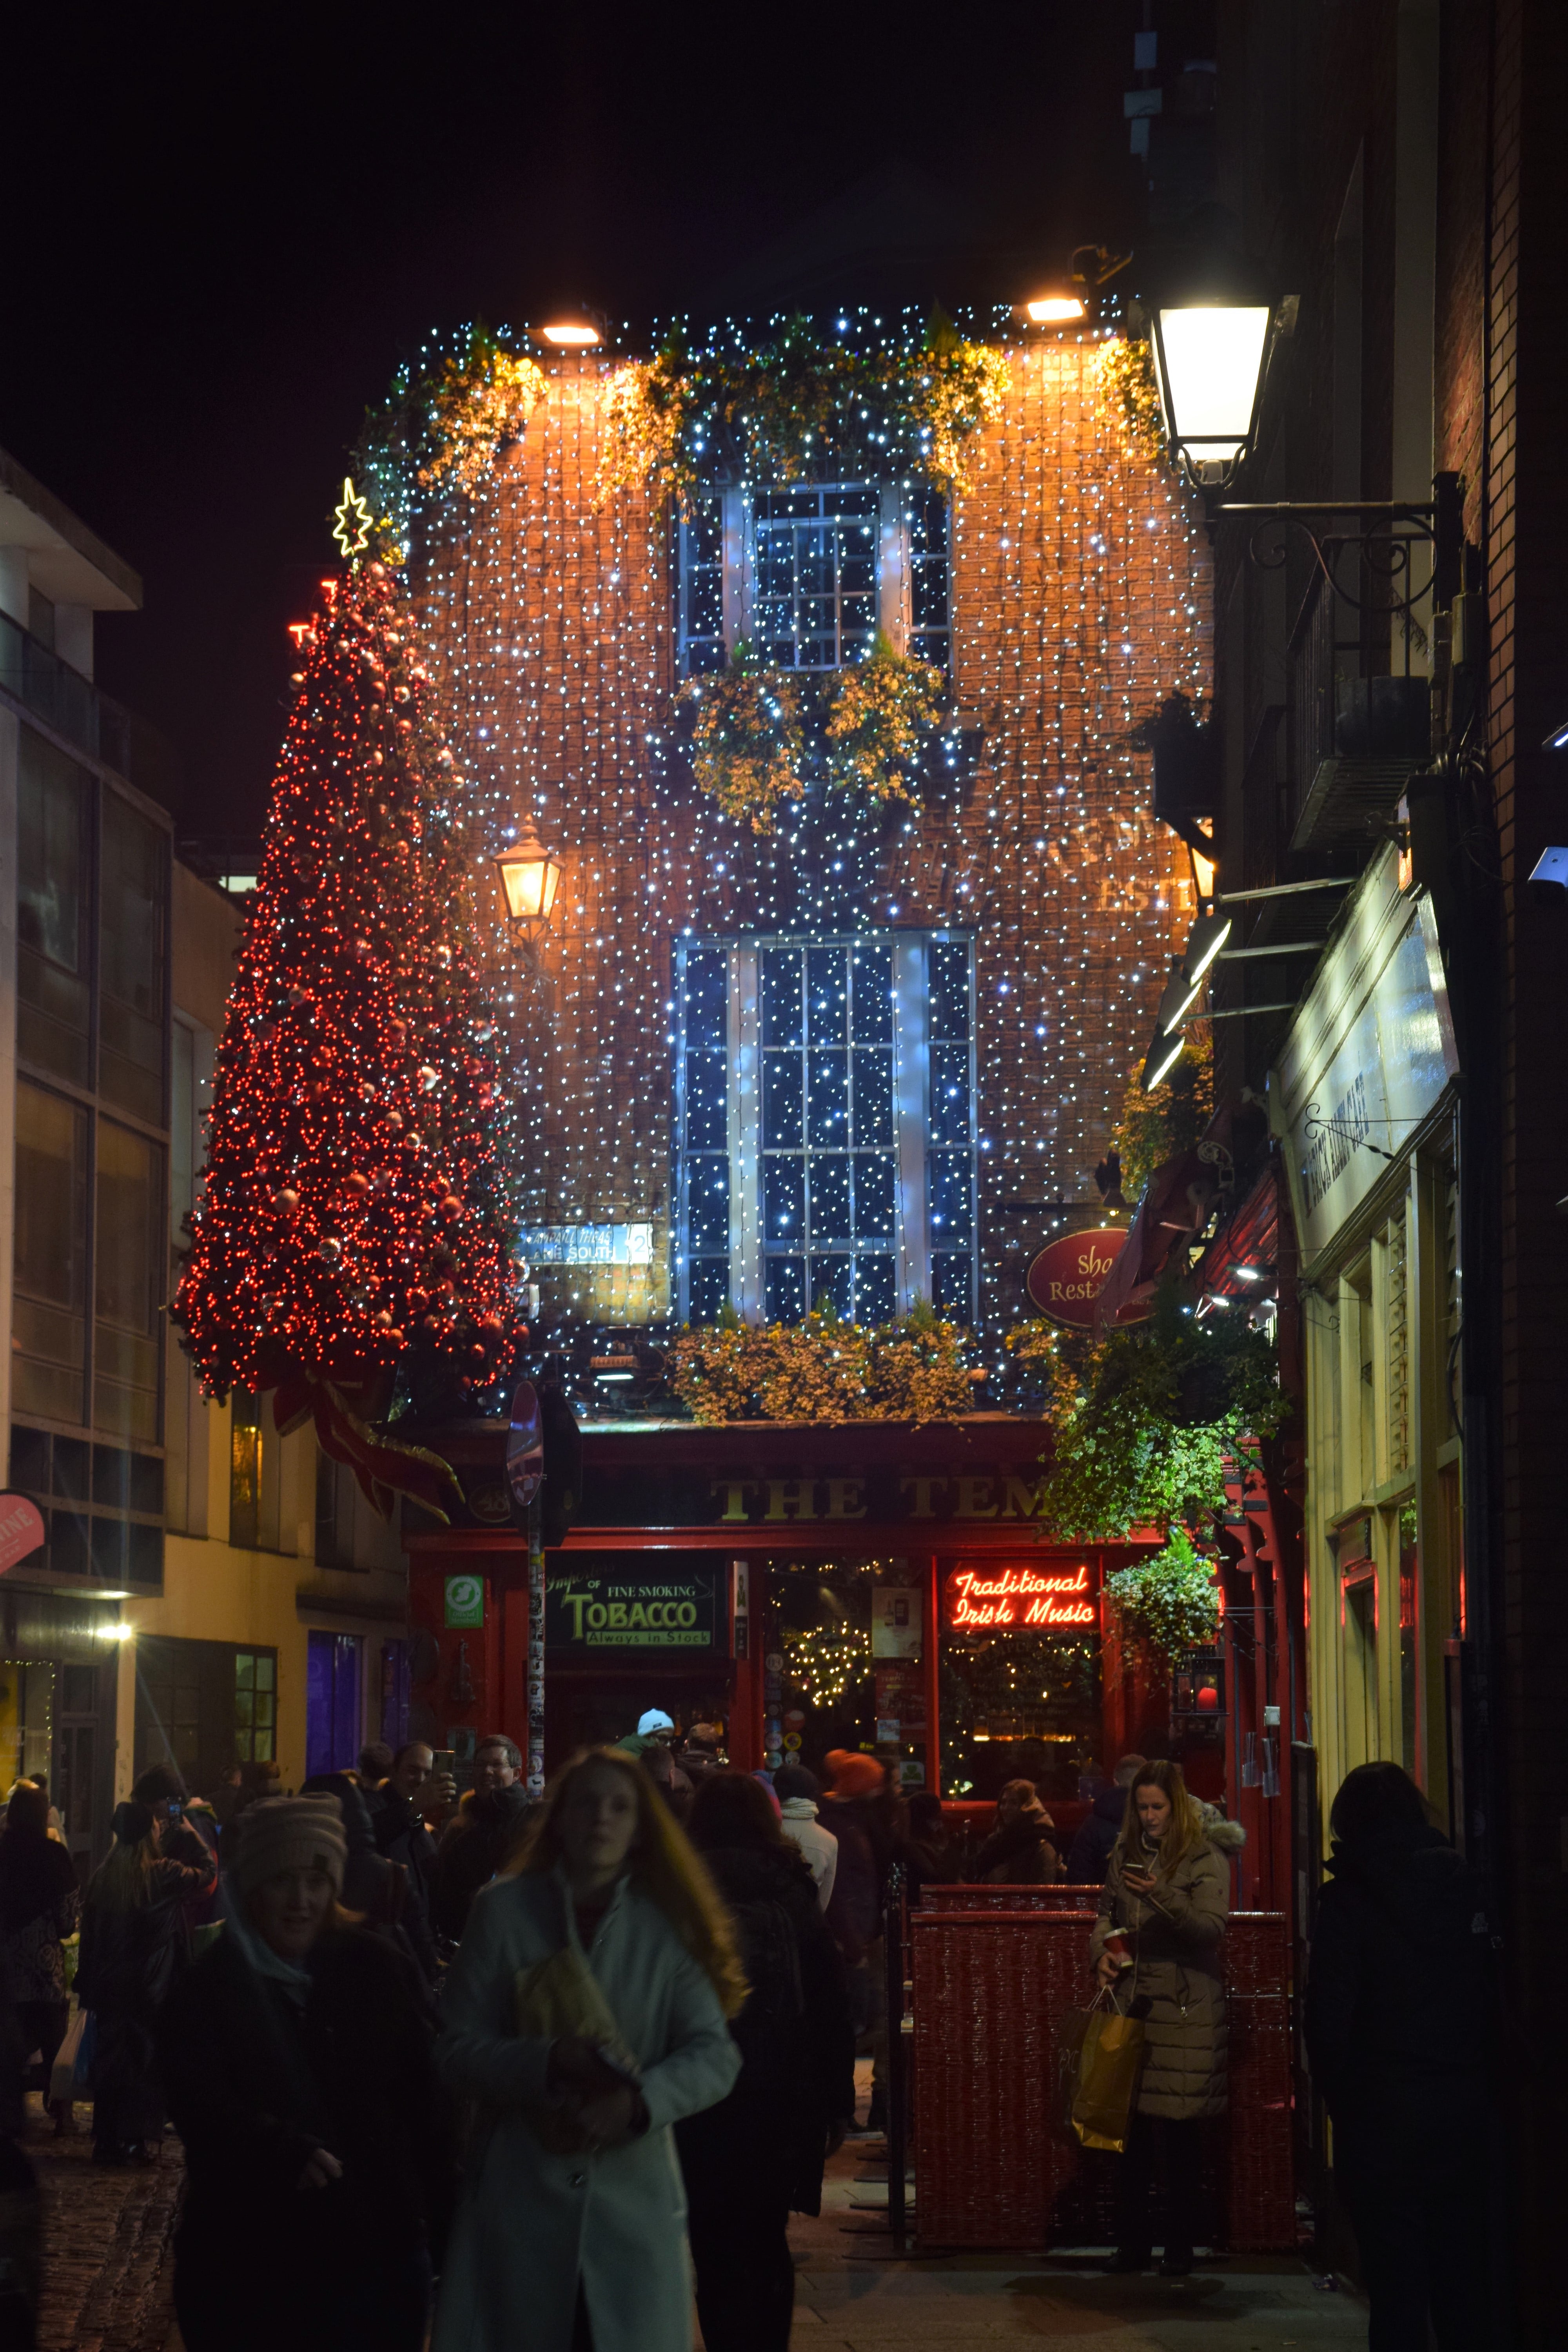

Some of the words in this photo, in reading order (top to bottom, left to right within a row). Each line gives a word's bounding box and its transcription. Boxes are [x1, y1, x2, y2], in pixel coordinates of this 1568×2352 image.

[1347, 1070, 1369, 1153] CAFE
[568, 1246, 616, 1260] SOUTH
[634, 1235, 646, 1252] 2
[1078, 1246, 1113, 1278] Sho
[1049, 1280, 1099, 1301] Rest
[710, 1479, 868, 1521] THE
[899, 1476, 1054, 1518] TEM
[0, 1507, 34, 1541] INE
[587, 1579, 602, 1590] OF
[608, 1586, 636, 1598] FINE
[639, 1586, 696, 1597] SMOKING
[955, 1566, 1089, 1597] Traditional
[561, 1593, 697, 1641] TOBACCO
[952, 1597, 1014, 1625] Irish
[1024, 1597, 1095, 1624] Music
[588, 1632, 640, 1645] Always
[648, 1632, 660, 1643] in
[667, 1632, 708, 1643] Stock
